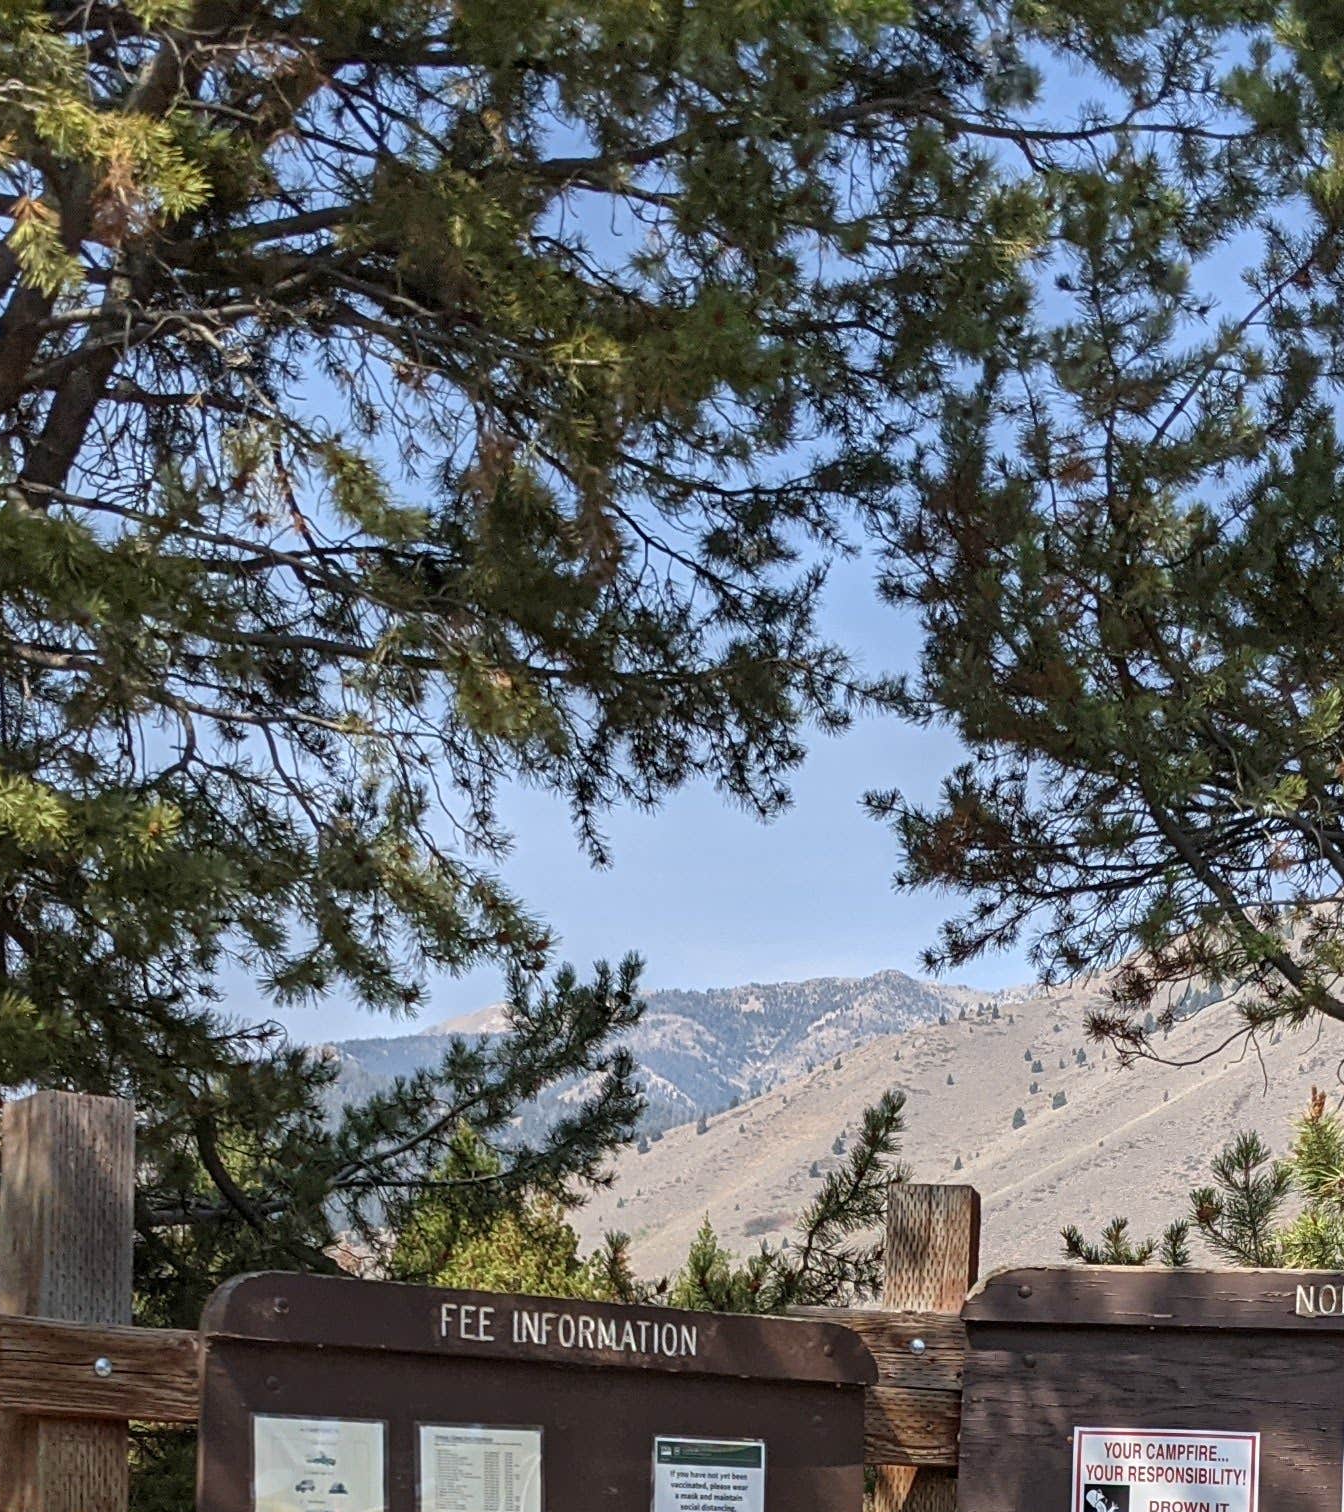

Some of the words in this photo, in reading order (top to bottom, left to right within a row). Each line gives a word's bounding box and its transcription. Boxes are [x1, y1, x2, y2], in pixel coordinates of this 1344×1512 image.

[441, 1303, 495, 1341] FEE
[513, 1310, 697, 1356] INFORMATION
[1104, 1443, 1142, 1459] YOUR
[1146, 1444, 1229, 1463] CAMPFIRE...
[676, 1471, 689, 1480] you
[691, 1471, 705, 1479] have
[707, 1472, 718, 1480] not
[720, 1473, 730, 1481] yet
[732, 1472, 747, 1480] been
[1086, 1464, 1123, 1481] YOUR
[1128, 1466, 1246, 1486] RESPONSIBILITY!
[671, 1481, 708, 1490] vaccinated,
[710, 1483, 731, 1492] please
[714, 1494, 743, 1502] maintain
